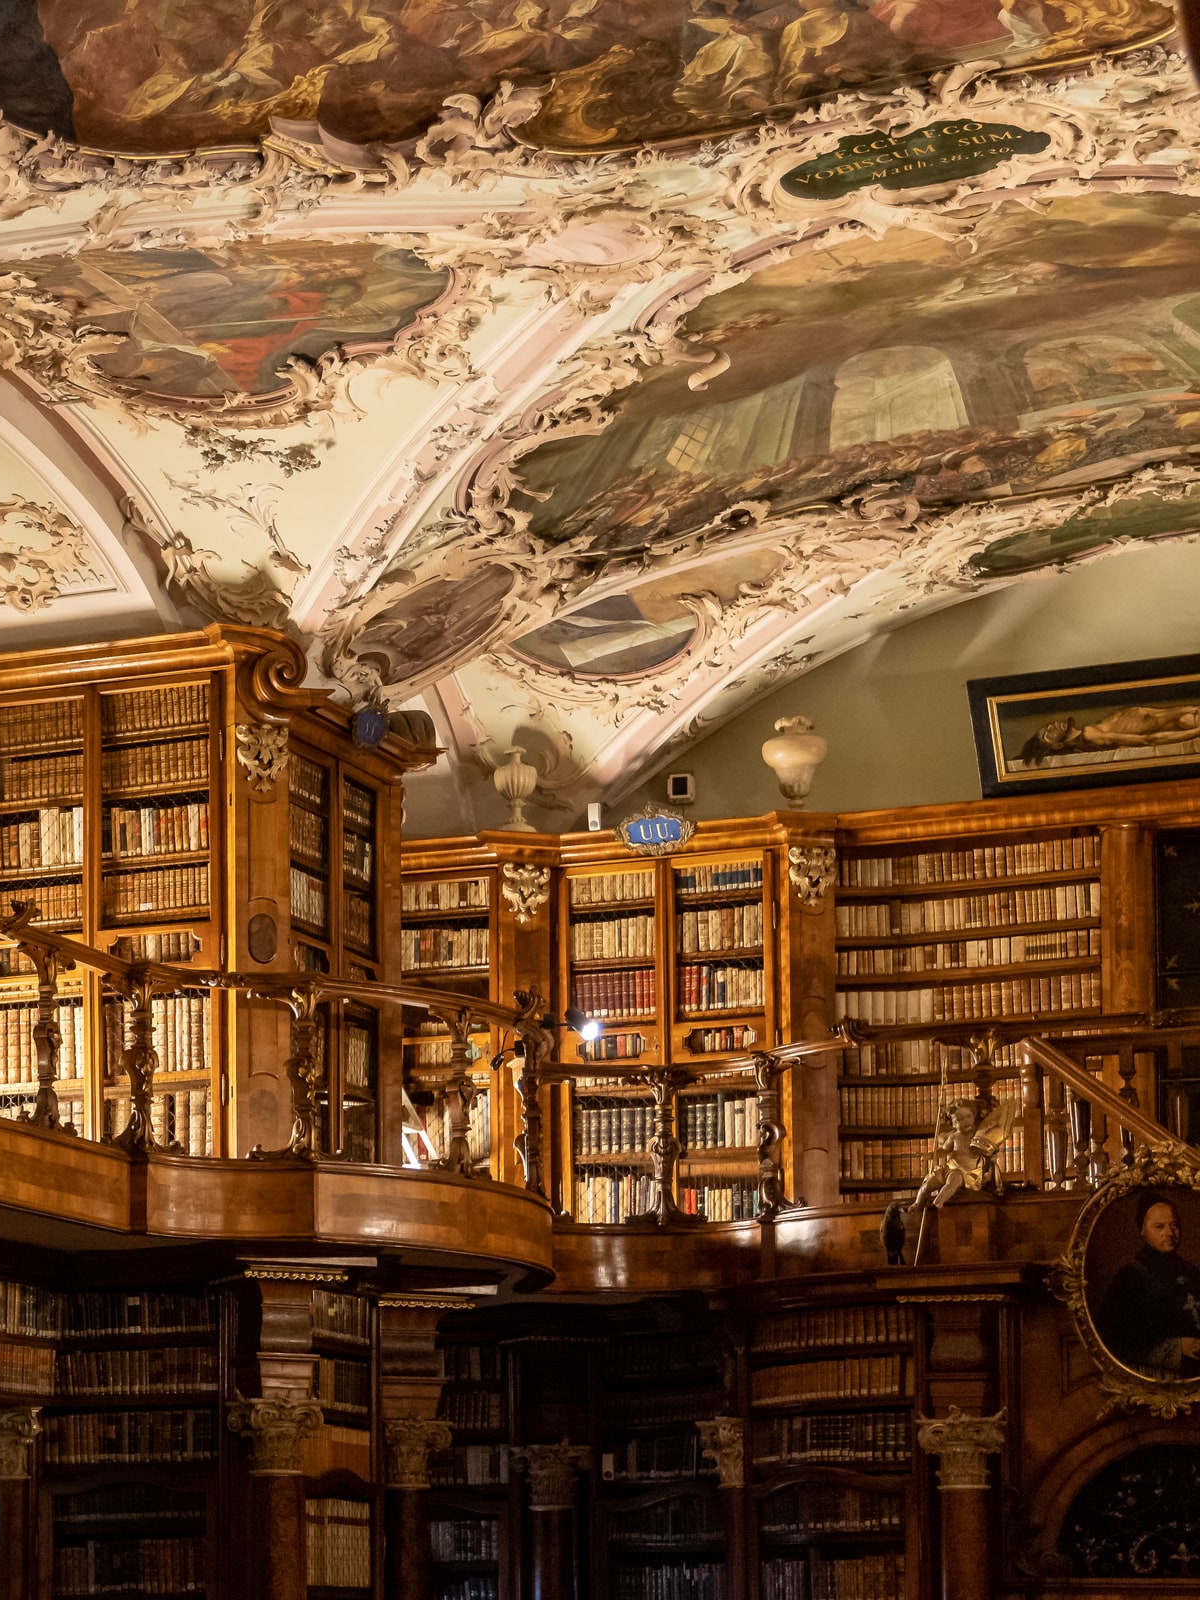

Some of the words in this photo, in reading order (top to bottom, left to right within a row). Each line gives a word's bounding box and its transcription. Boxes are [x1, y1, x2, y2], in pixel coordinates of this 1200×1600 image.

[794, 144, 937, 184] VOBISCUM
[957, 130, 1023, 147] SUM.
[834, 137, 906, 160] ECCE
[639, 822, 675, 841] UU.
